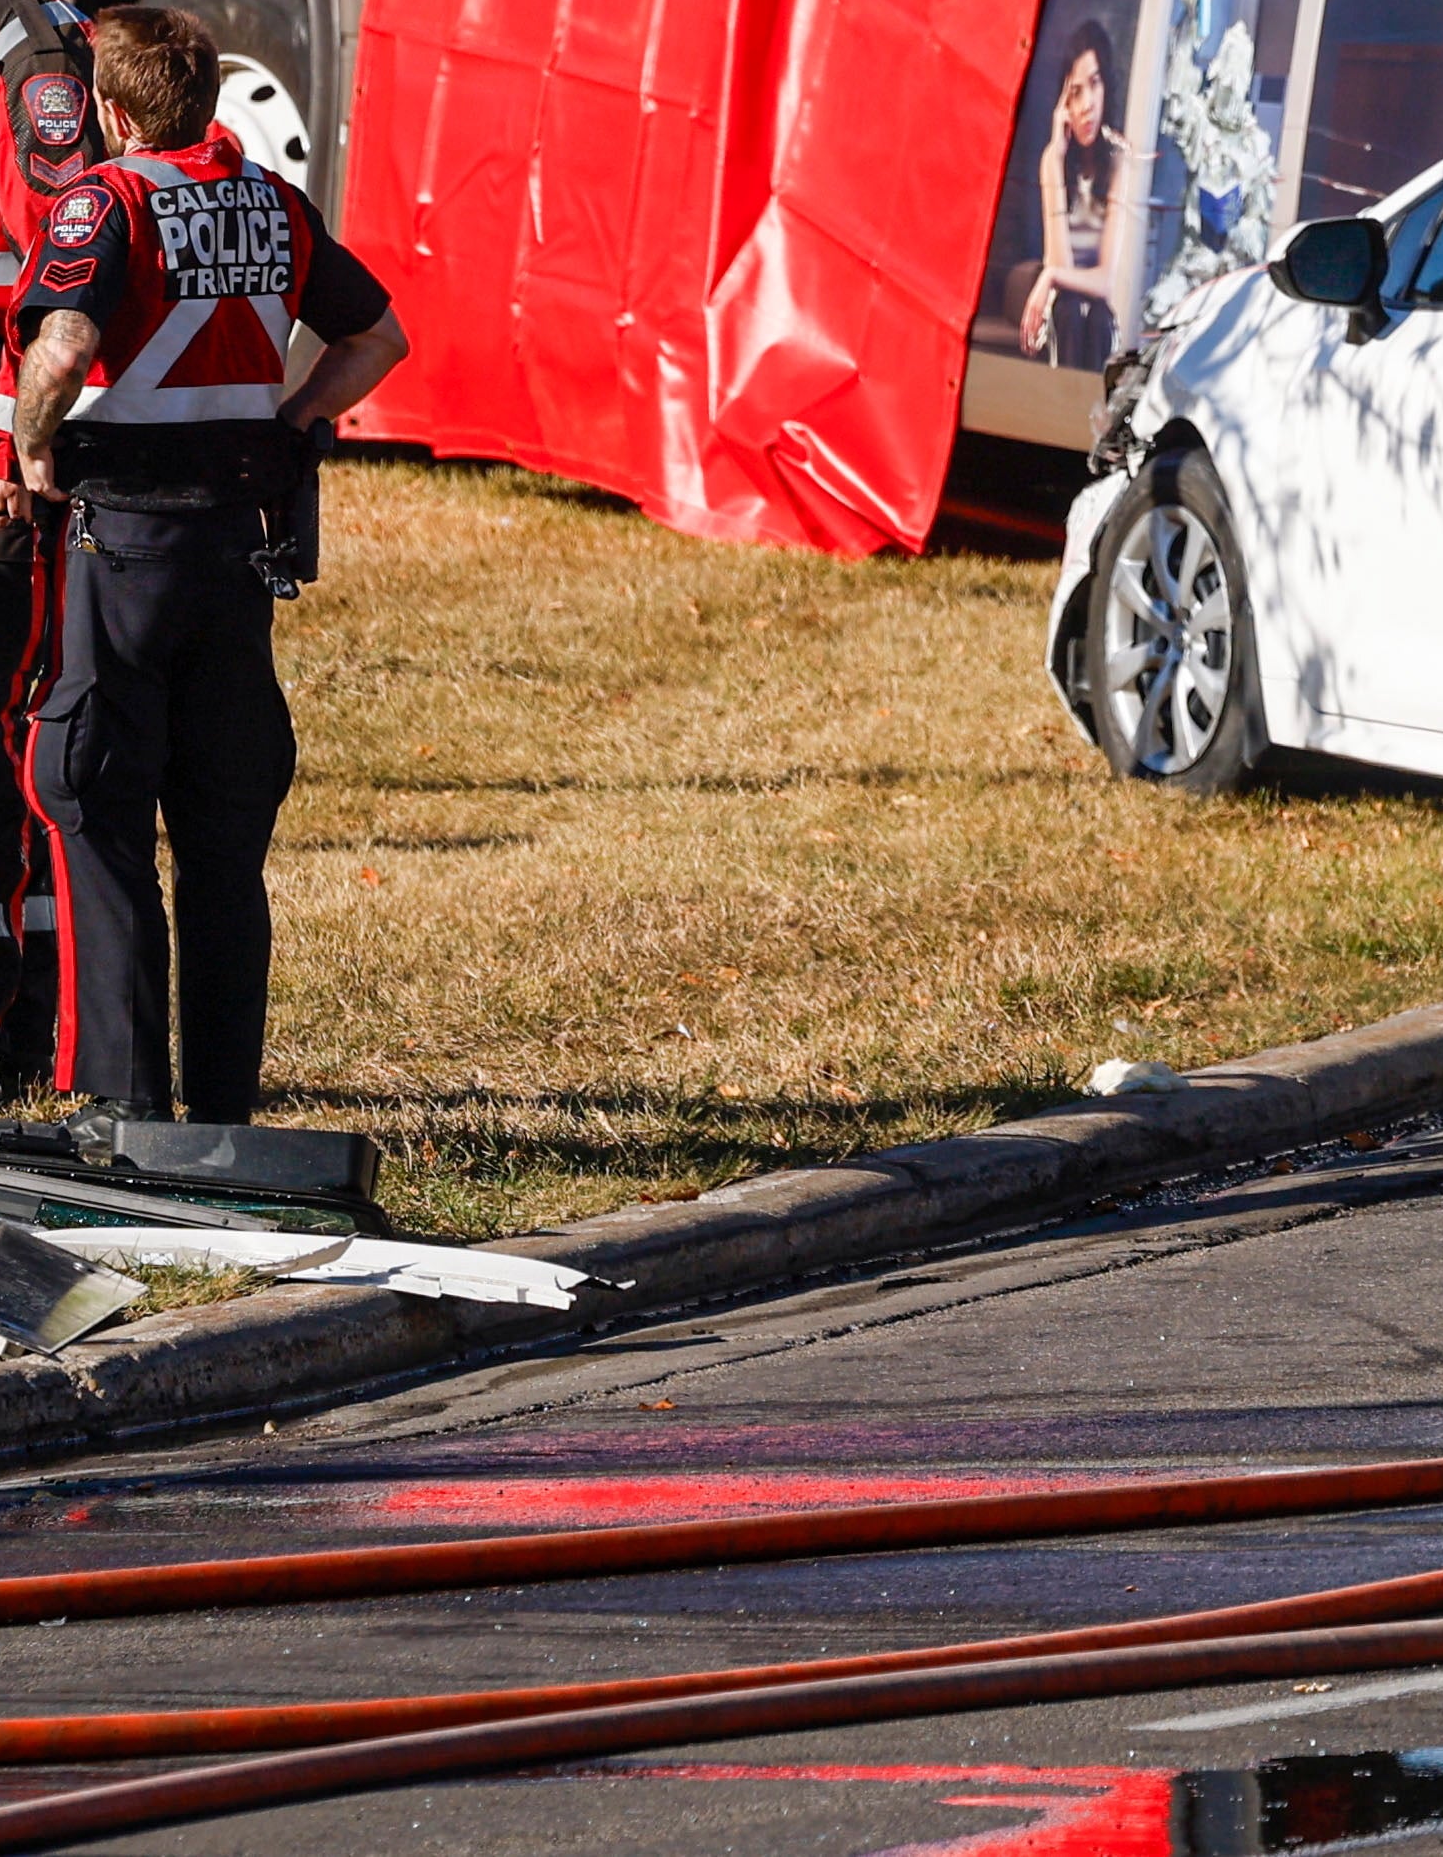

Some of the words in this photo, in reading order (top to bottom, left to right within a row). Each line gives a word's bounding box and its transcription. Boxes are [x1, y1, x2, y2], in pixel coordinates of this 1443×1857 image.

[38, 119, 78, 128] POLICE
[150, 178, 279, 216] CALGARY
[54, 224, 92, 233] POLICE
[157, 210, 292, 270] POLICE
[176, 265, 289, 296] TRAFFIC
